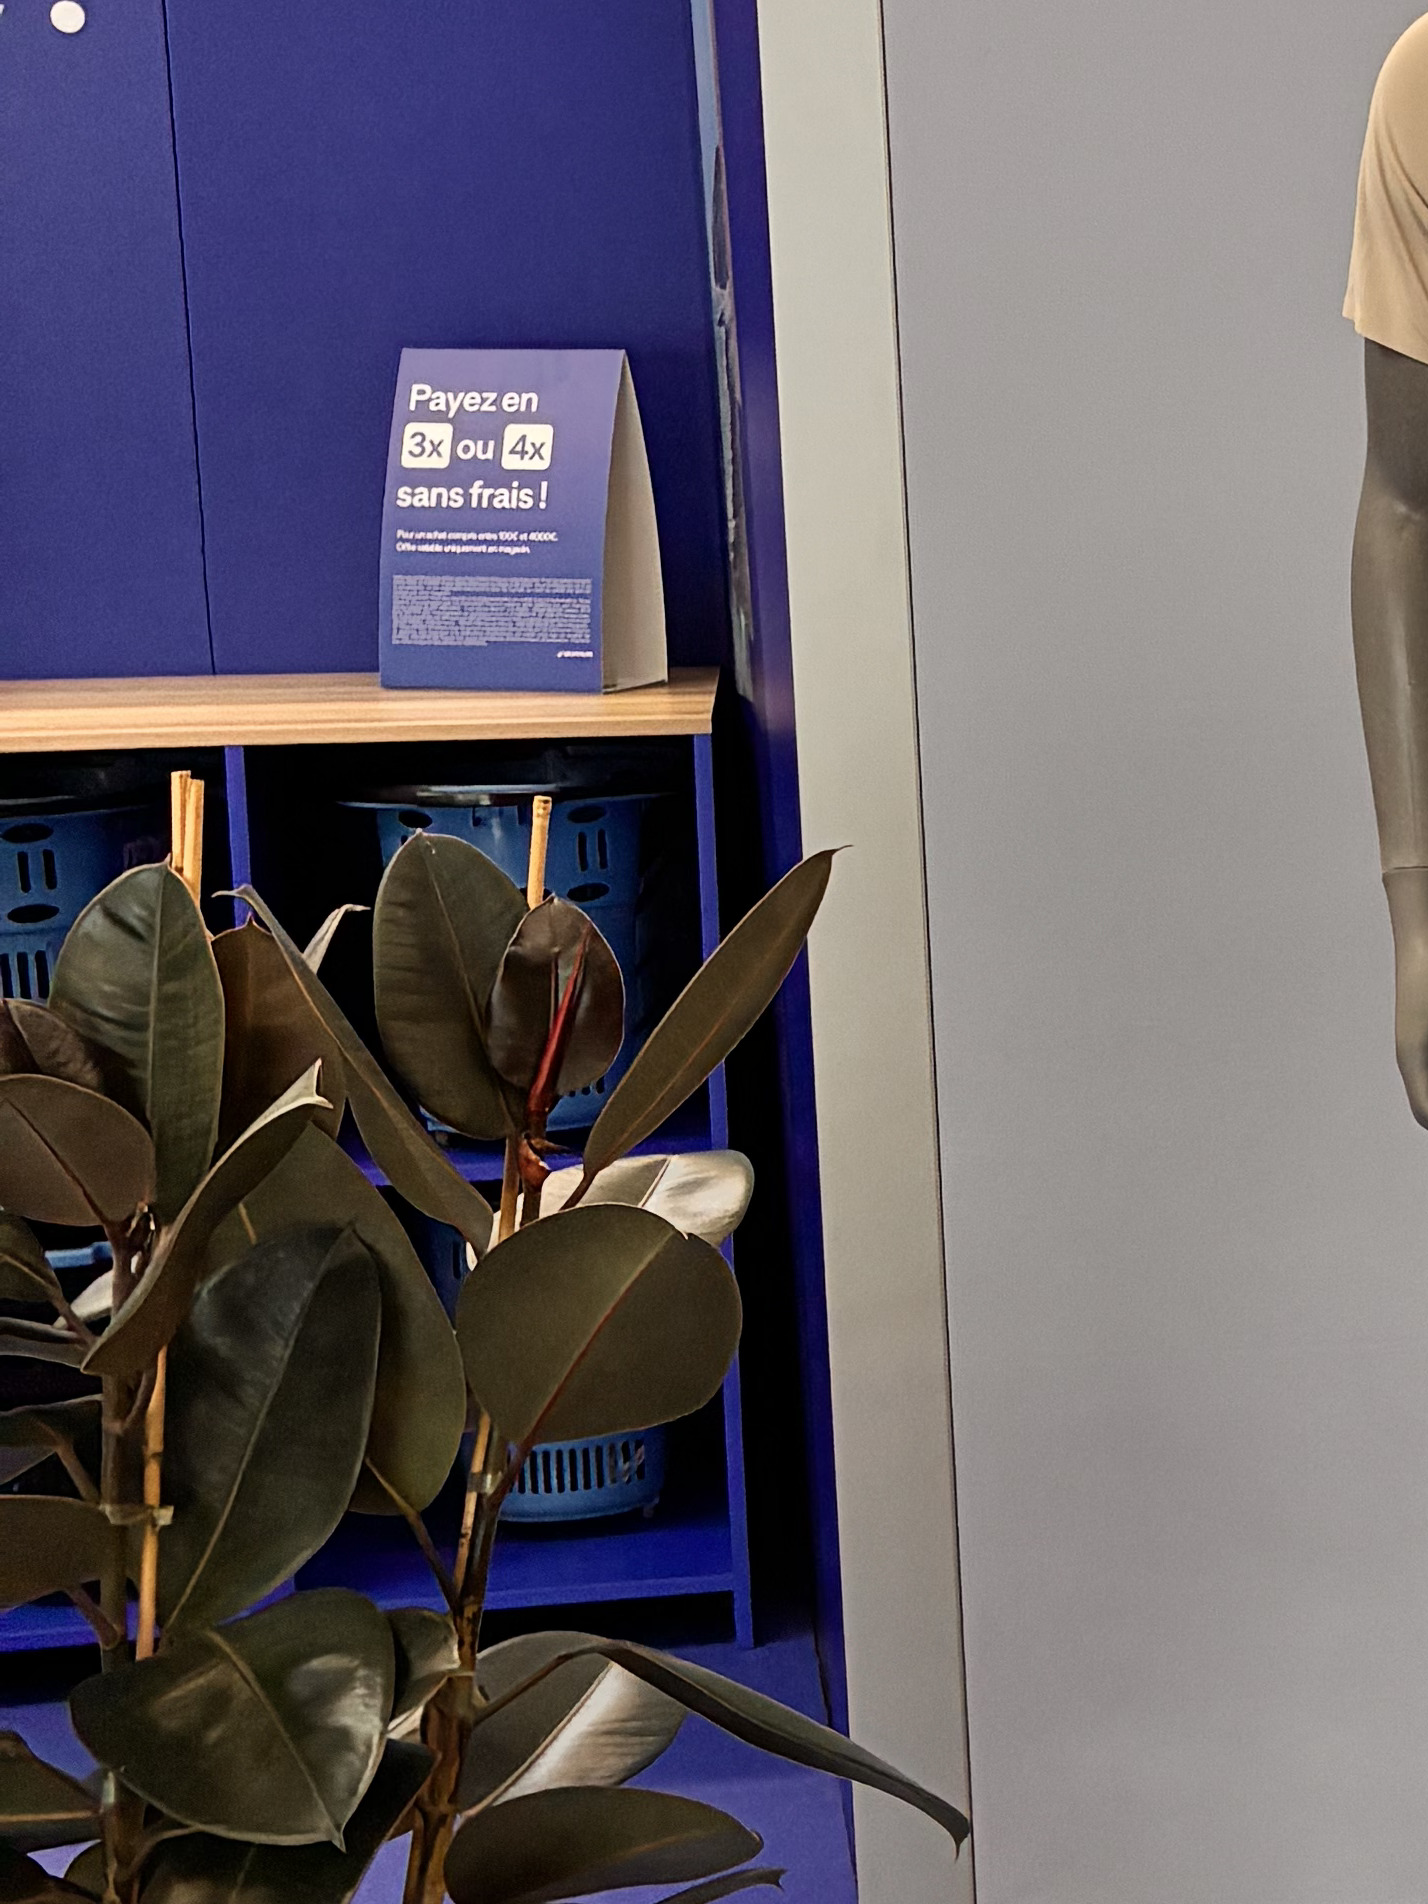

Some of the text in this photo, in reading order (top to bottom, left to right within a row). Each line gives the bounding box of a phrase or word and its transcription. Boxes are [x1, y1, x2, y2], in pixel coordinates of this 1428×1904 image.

[408, 384, 539, 418] Payez en
[408, 431, 546, 461] 3x ou 4x
[396, 484, 464, 509] sans
[469, 480, 534, 510] frais
